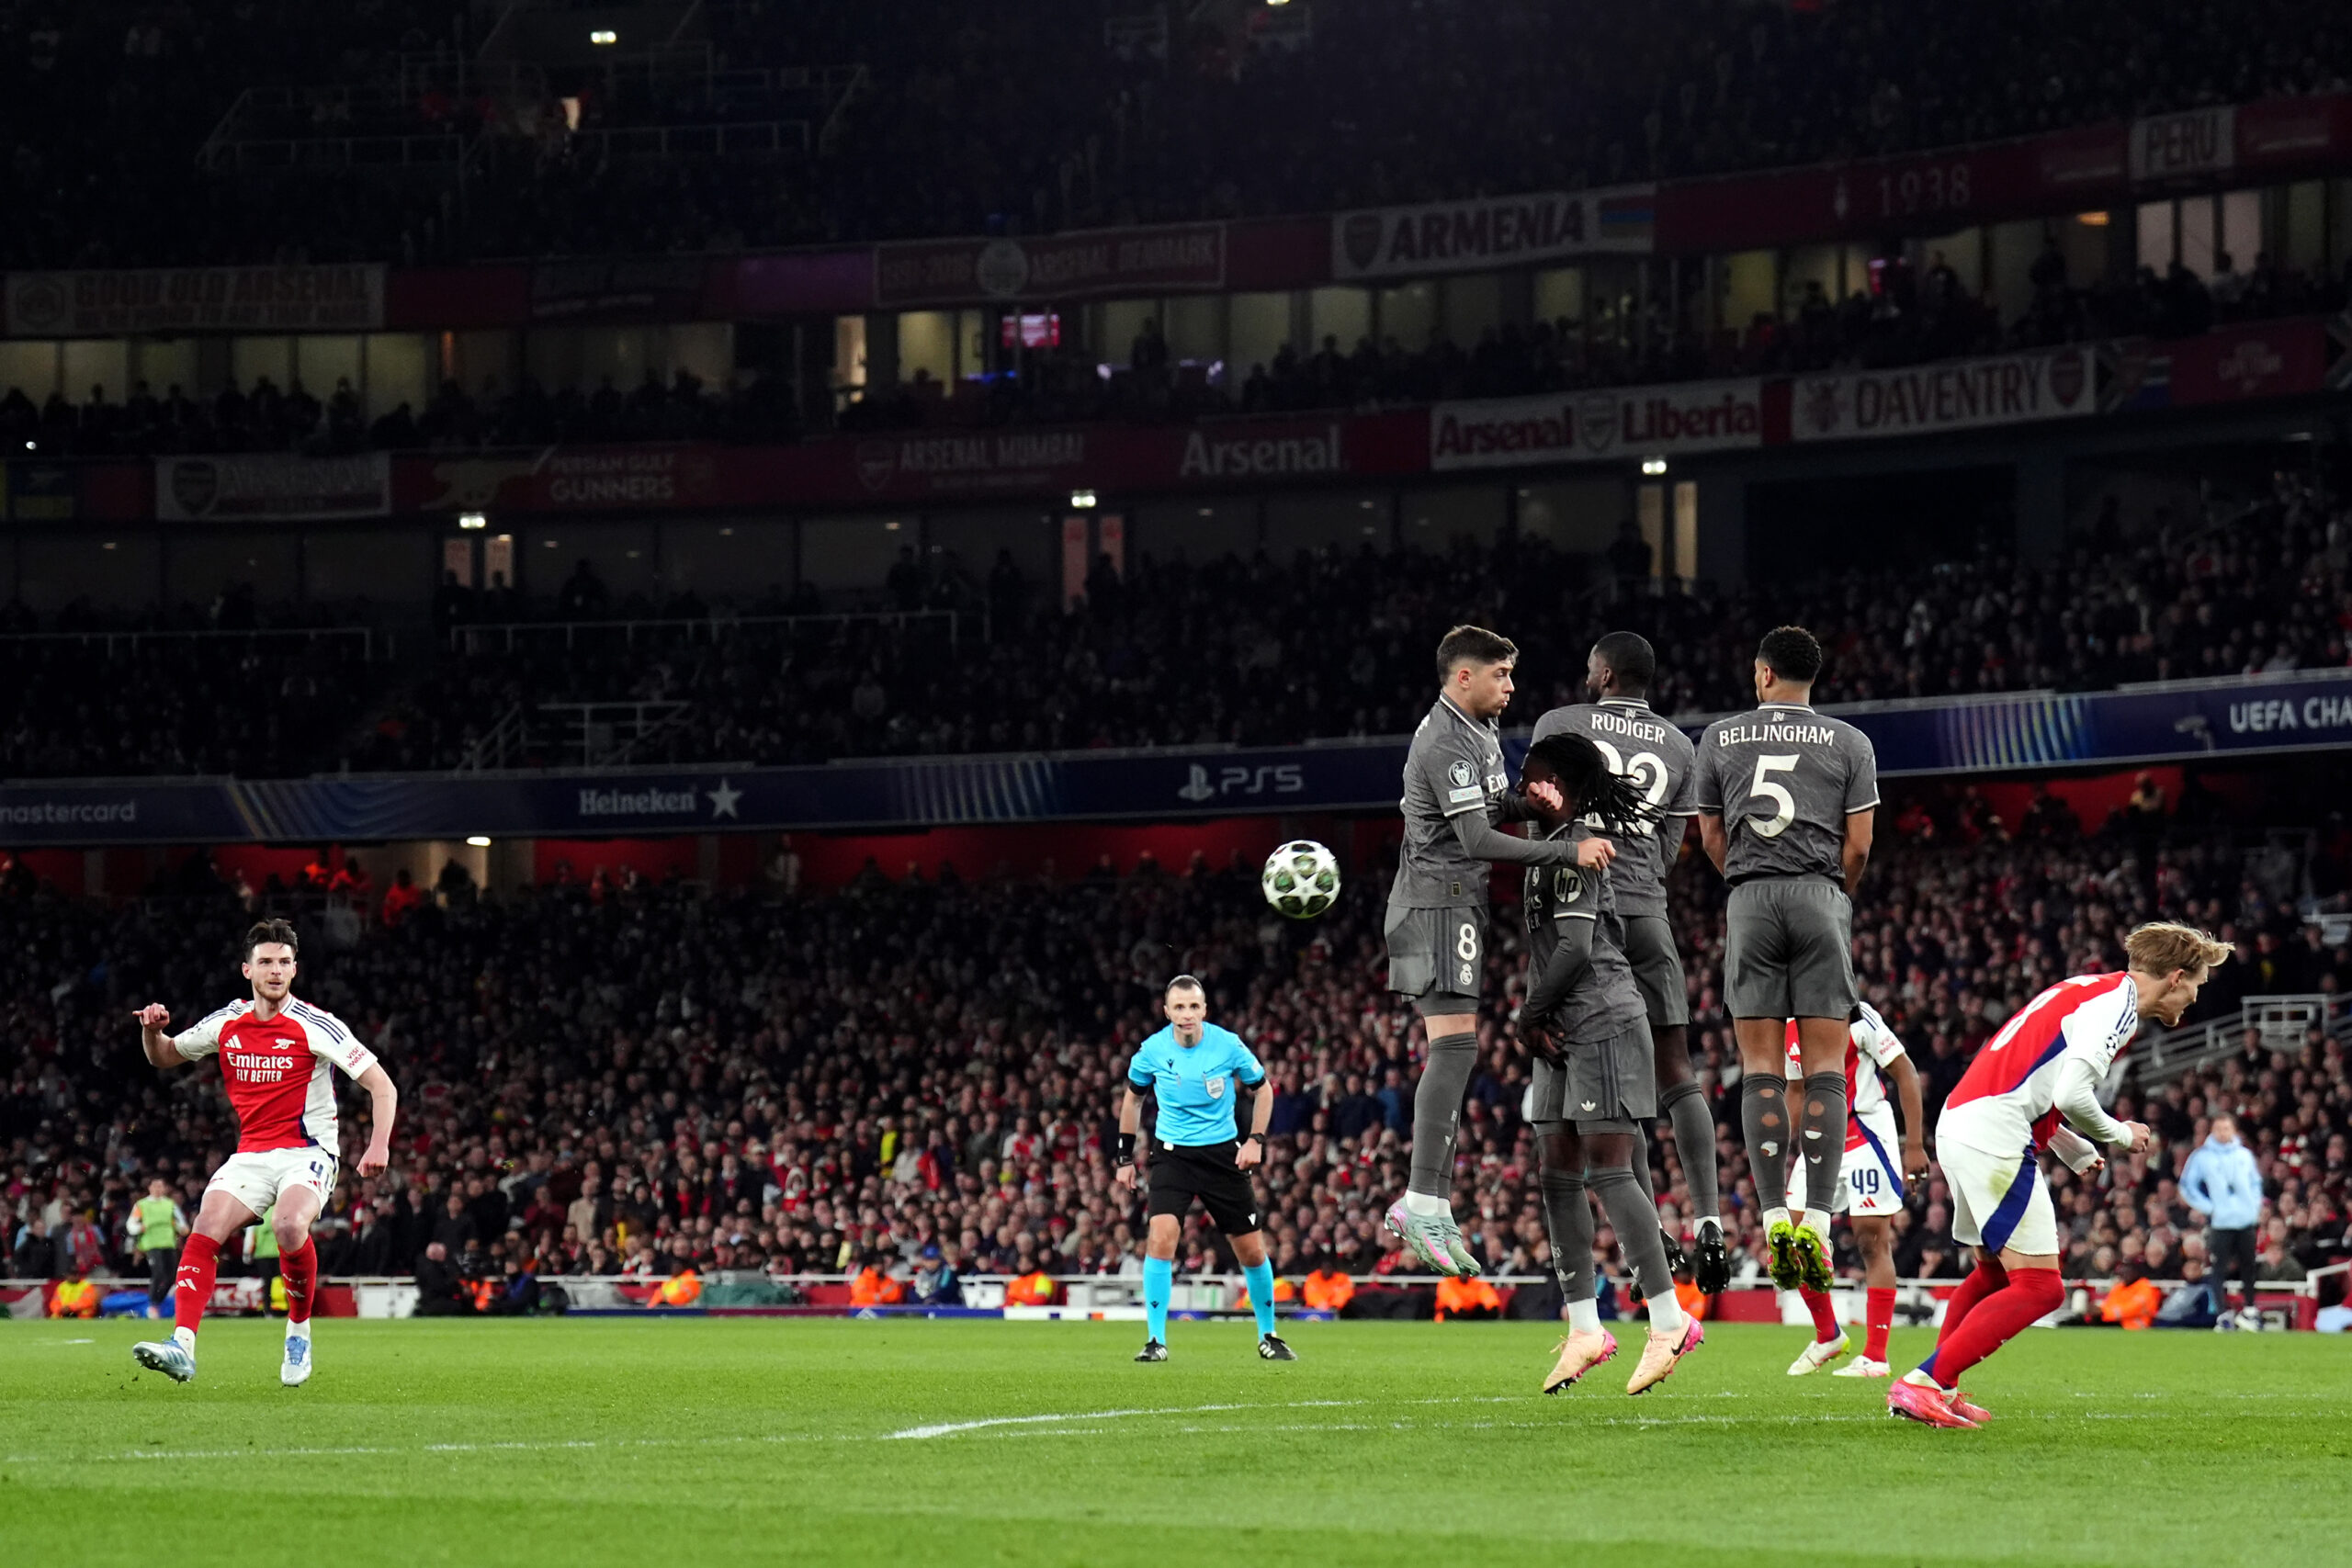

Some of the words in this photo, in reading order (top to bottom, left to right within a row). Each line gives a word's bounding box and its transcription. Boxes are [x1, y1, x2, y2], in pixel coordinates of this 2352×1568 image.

[2145, 113, 2218, 169] PERU
[1877, 163, 1971, 216] 1938
[1387, 199, 1585, 263] ARMENIA
[1118, 234, 1215, 273] DENMARK
[74, 273, 161, 307] GOOD
[169, 271, 228, 303] OLD
[233, 268, 368, 302] ARSENAL
[1855, 353, 2042, 429] DAVENTRY
[1436, 406, 1573, 456] Arsenal
[1623, 392, 1759, 444] Liberia
[628, 453, 675, 471] GULF
[900, 439, 991, 472] ARSENAL
[997, 433, 1084, 467] MUMBAI
[1180, 423, 1340, 478] Arsenal
[549, 476, 675, 502] GUNNERS
[1591, 713, 1667, 745] RÜDIGER
[2229, 698, 2299, 734] UEFA
[1719, 724, 1835, 747] BELLINGHAM
[1219, 764, 1304, 795] PS5
[1743, 753, 1801, 838] 5
[578, 786, 697, 816] Heineken
[1557, 868, 1578, 904] hp
[1458, 923, 1476, 961] 8
[227, 1052, 294, 1069] Emirates
[236, 1068, 249, 1082] FLY
[251, 1069, 283, 1083] BETTER
[310, 1161, 323, 1179] 4
[1851, 1168, 1879, 1195] 49
[177, 1265, 201, 1274] AFC
